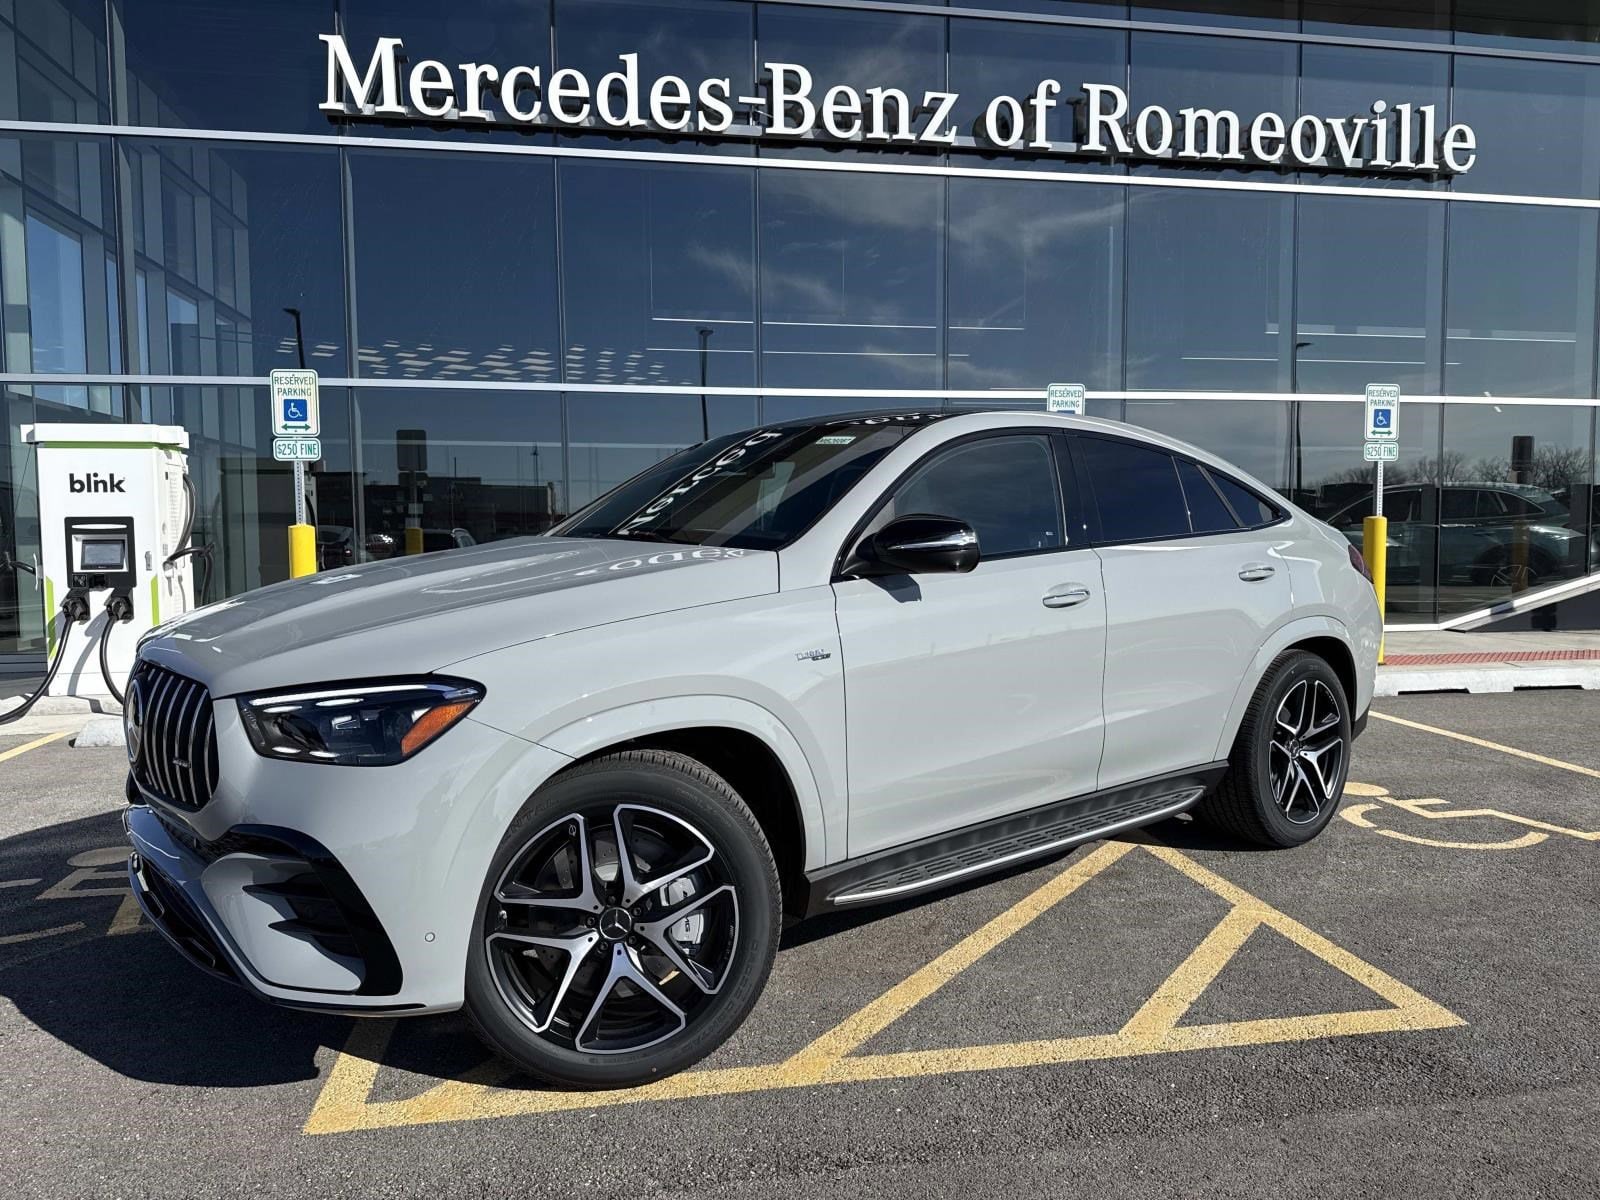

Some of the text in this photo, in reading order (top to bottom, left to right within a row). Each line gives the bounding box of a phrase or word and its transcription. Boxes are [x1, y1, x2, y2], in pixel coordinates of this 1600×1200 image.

[318, 34, 1477, 171] Mercedes-Benz of Romeoville
[274, 376, 314, 385] RESERVED
[277, 388, 312, 397] PARKING
[1051, 390, 1082, 398] RESERVED
[1368, 389, 1397, 397] RESERVED
[1052, 400, 1080, 408] PARKING
[1370, 399, 1395, 407] PARKING
[277, 443, 317, 455] $250 FINE
[1367, 446, 1396, 457] $250 FINE
[69, 472, 126, 493] blink
